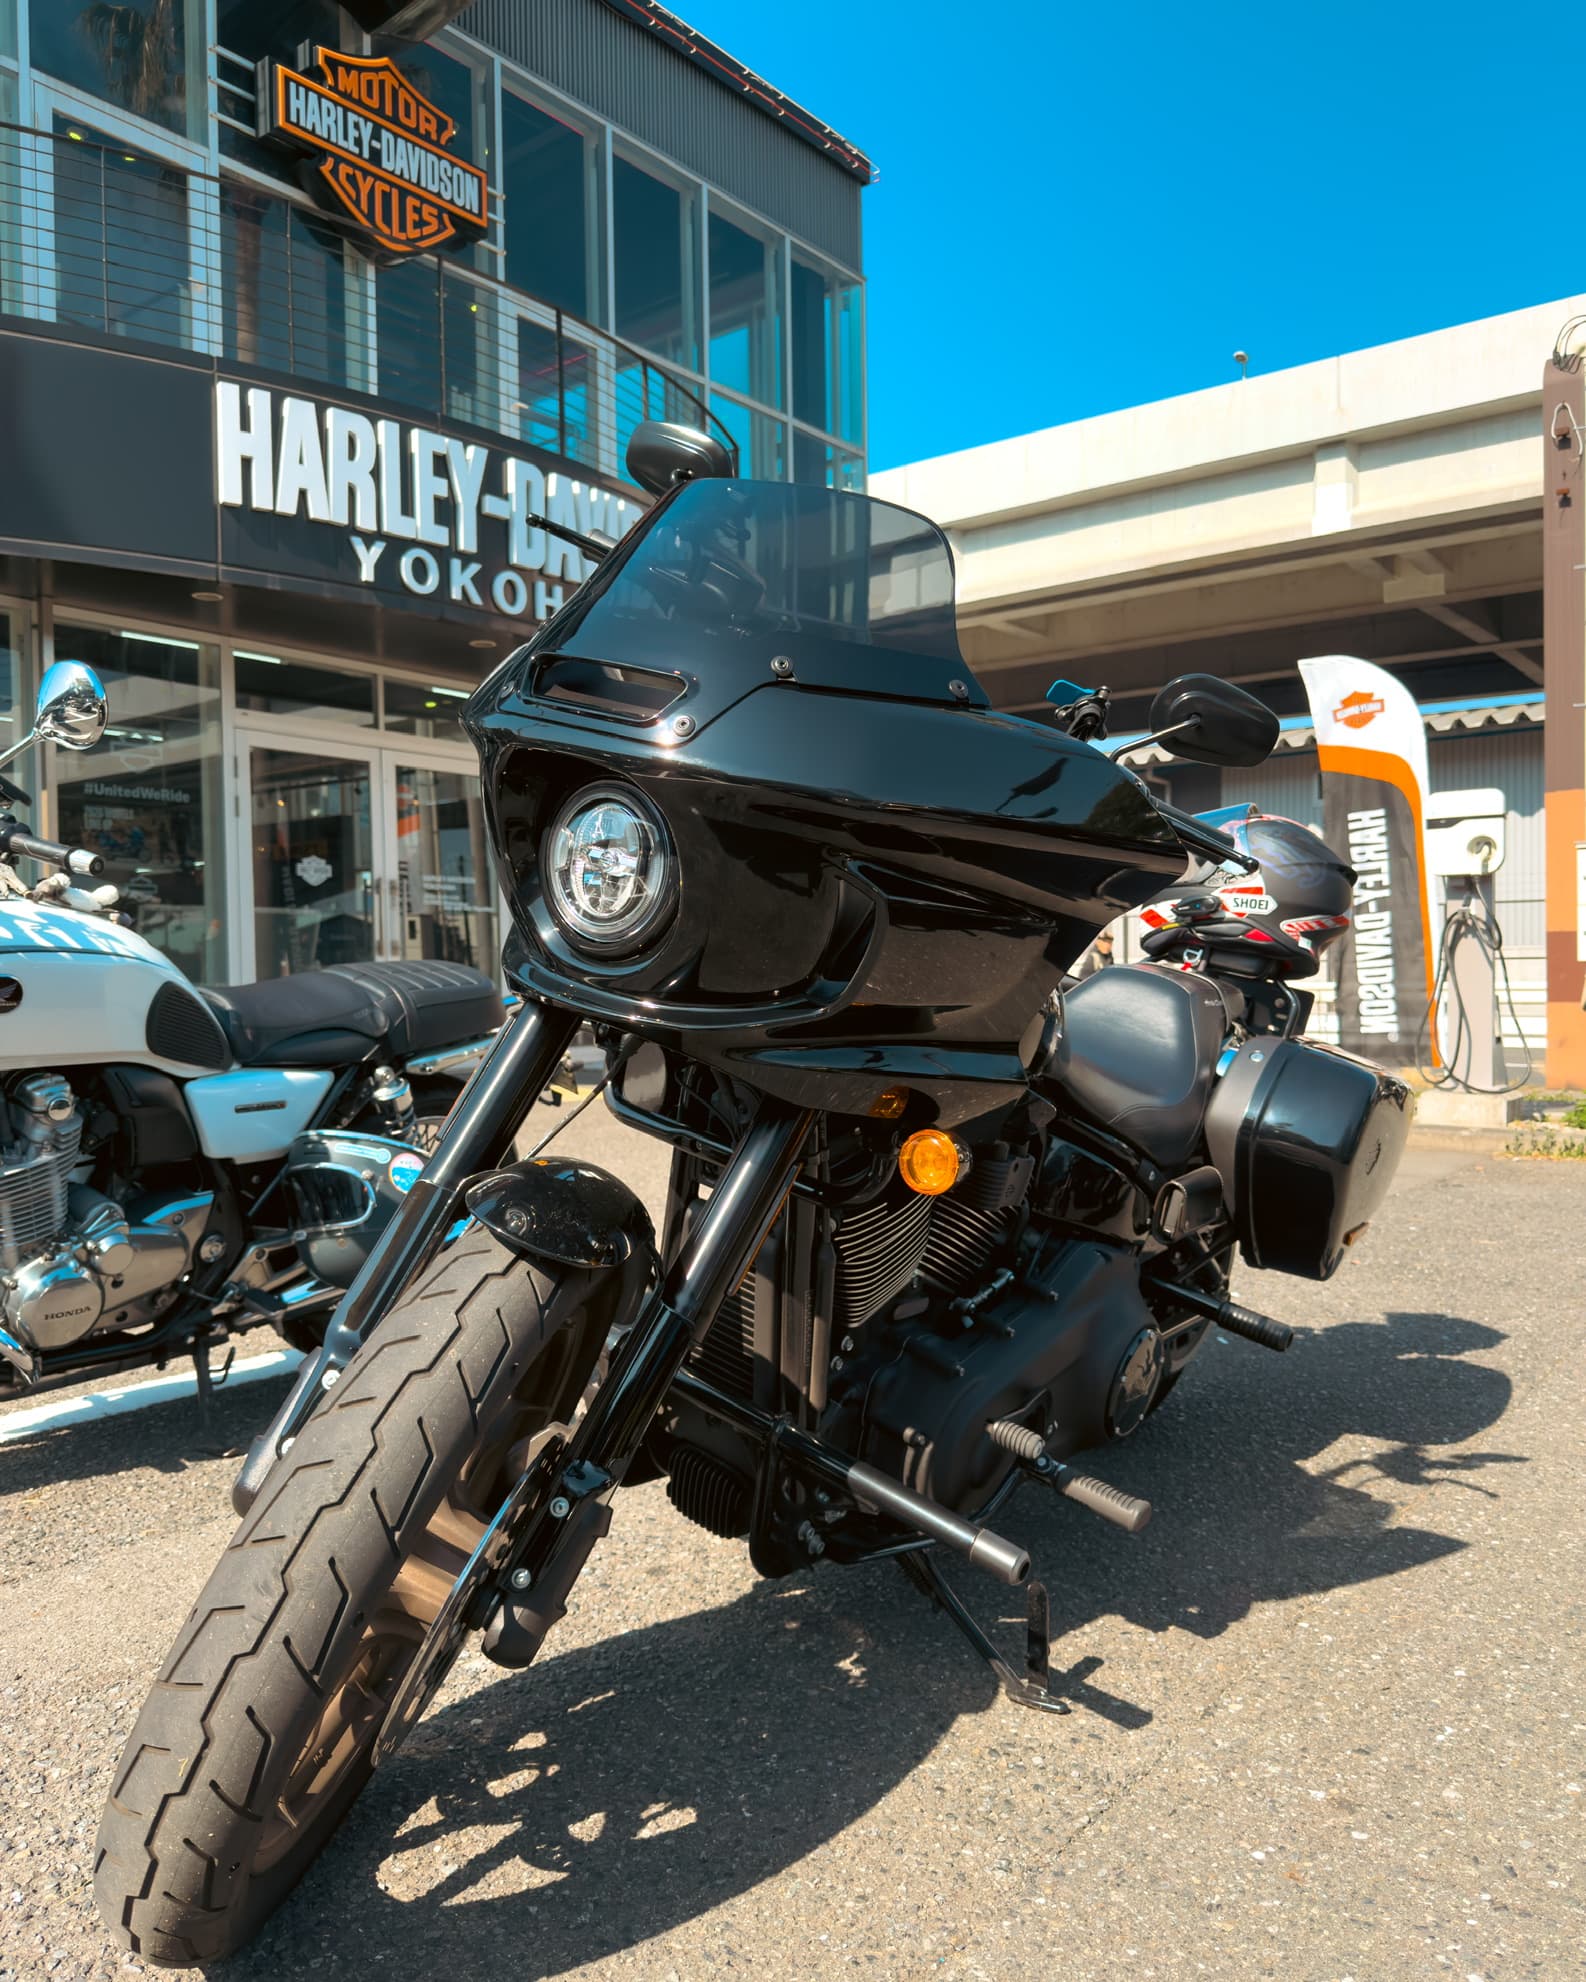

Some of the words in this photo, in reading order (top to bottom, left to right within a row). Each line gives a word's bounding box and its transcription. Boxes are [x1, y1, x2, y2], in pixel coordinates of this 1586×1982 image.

[337, 66, 438, 141] MOTOR
[289, 81, 480, 214] HARLEY-DAVIDSON
[338, 162, 439, 241] CYCLES
[83, 782, 191, 803] #UnitedWeRide
[1233, 897, 1269, 910] SHOEI
[44, 1306, 91, 1320] HONDA
